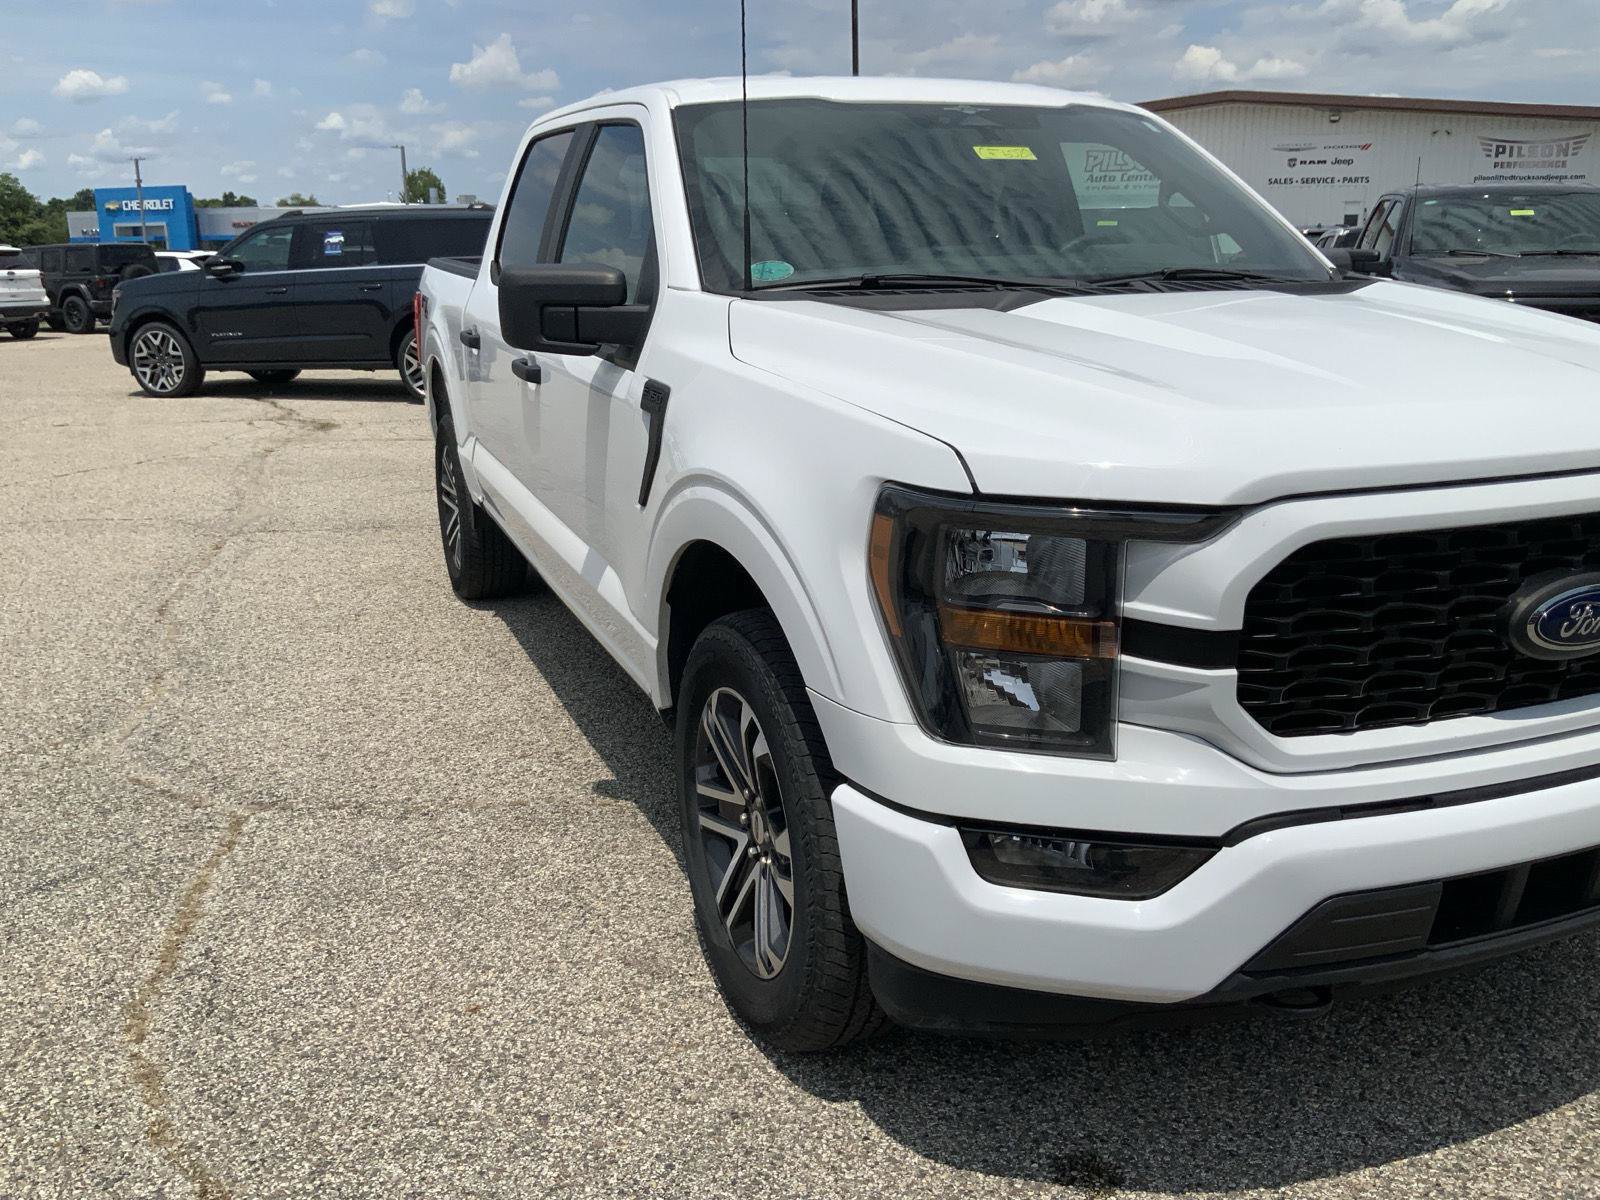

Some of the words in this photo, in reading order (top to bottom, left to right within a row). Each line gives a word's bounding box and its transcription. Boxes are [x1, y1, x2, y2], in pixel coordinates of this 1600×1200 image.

[1494, 143, 1570, 158] PILSON
[1331, 157, 1354, 166] Jeep
[1493, 160, 1567, 169] PERFORMANCE
[1086, 173, 1116, 183] Auto
[1268, 177, 1294, 185] SALES
[1342, 176, 1370, 184] PARTS
[1560, 601, 1600, 638] For
